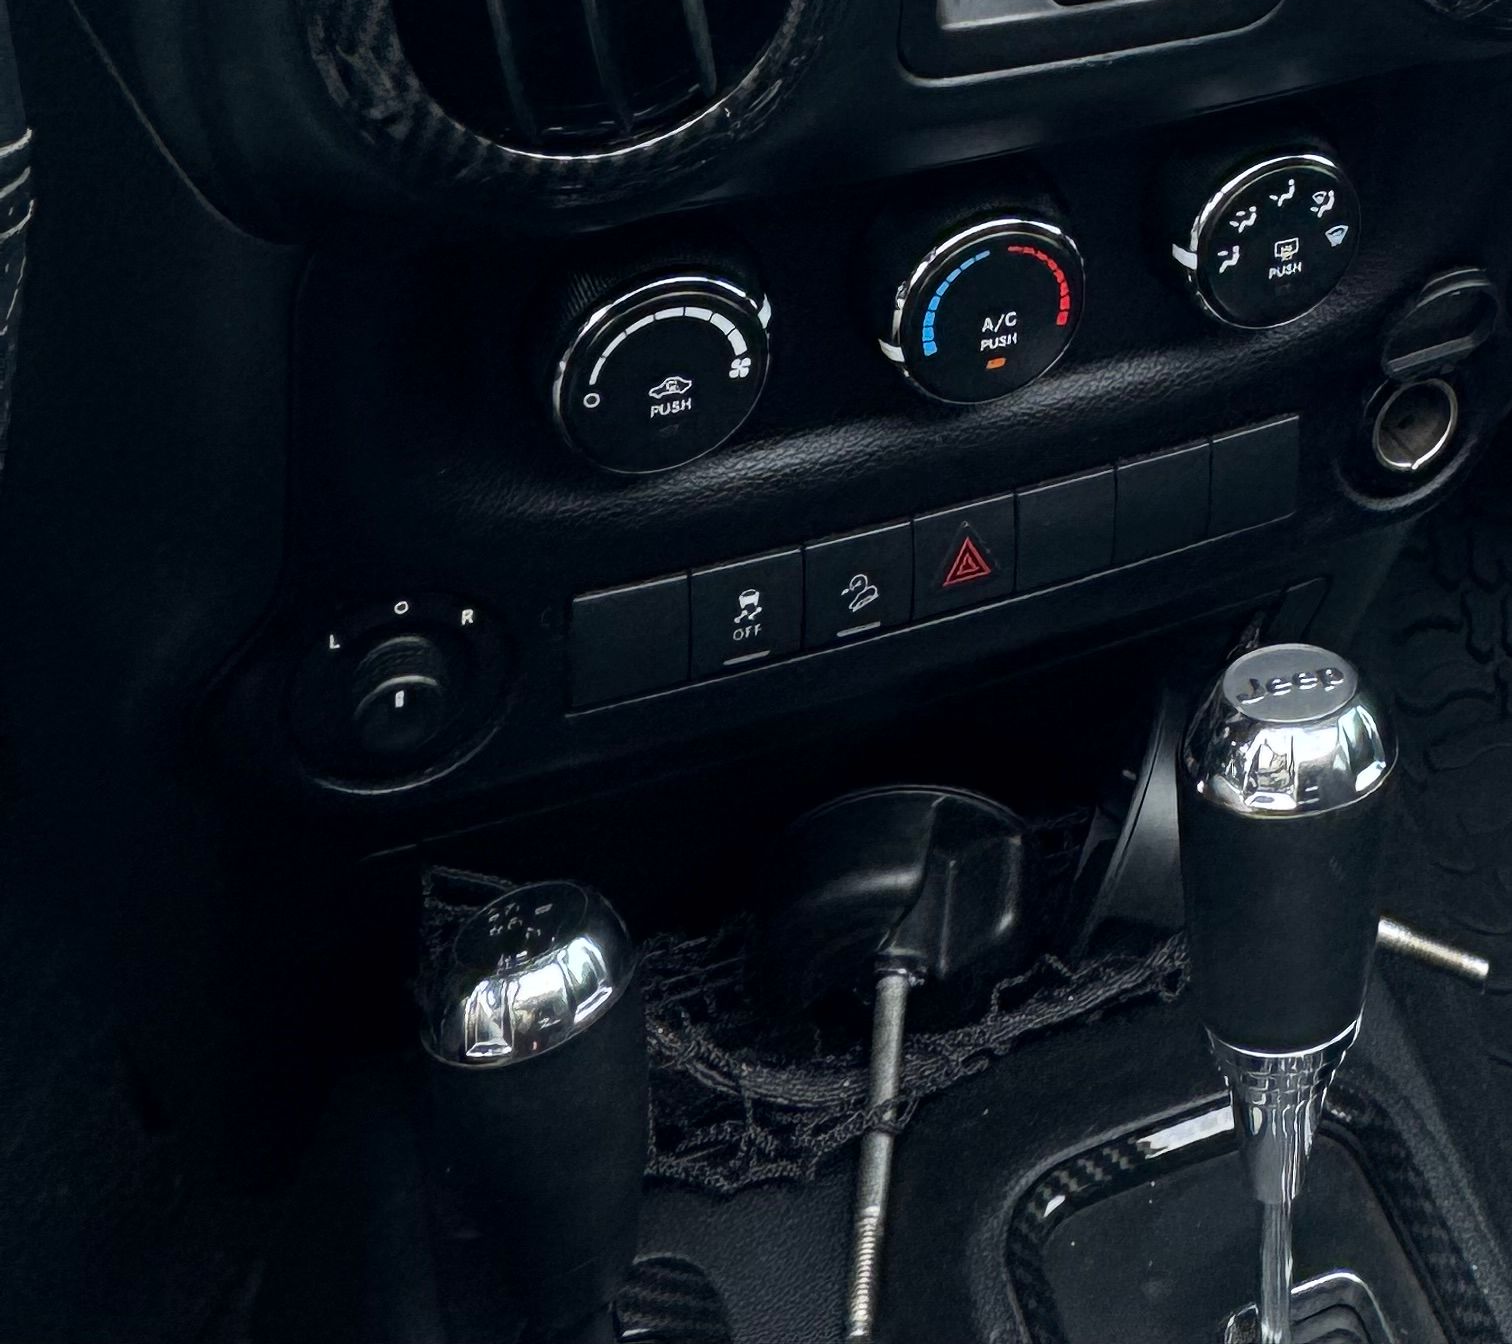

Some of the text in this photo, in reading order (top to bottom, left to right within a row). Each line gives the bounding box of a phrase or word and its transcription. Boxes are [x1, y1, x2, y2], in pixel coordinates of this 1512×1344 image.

[1268, 260, 1303, 280] PUSH
[981, 311, 1018, 334] A/C
[980, 332, 1018, 353] PUSH
[649, 397, 693, 419] PUSH
[460, 608, 475, 626] R
[329, 634, 341, 650] L
[733, 623, 762, 641] OFF
[1236, 666, 1345, 705] Jeep
